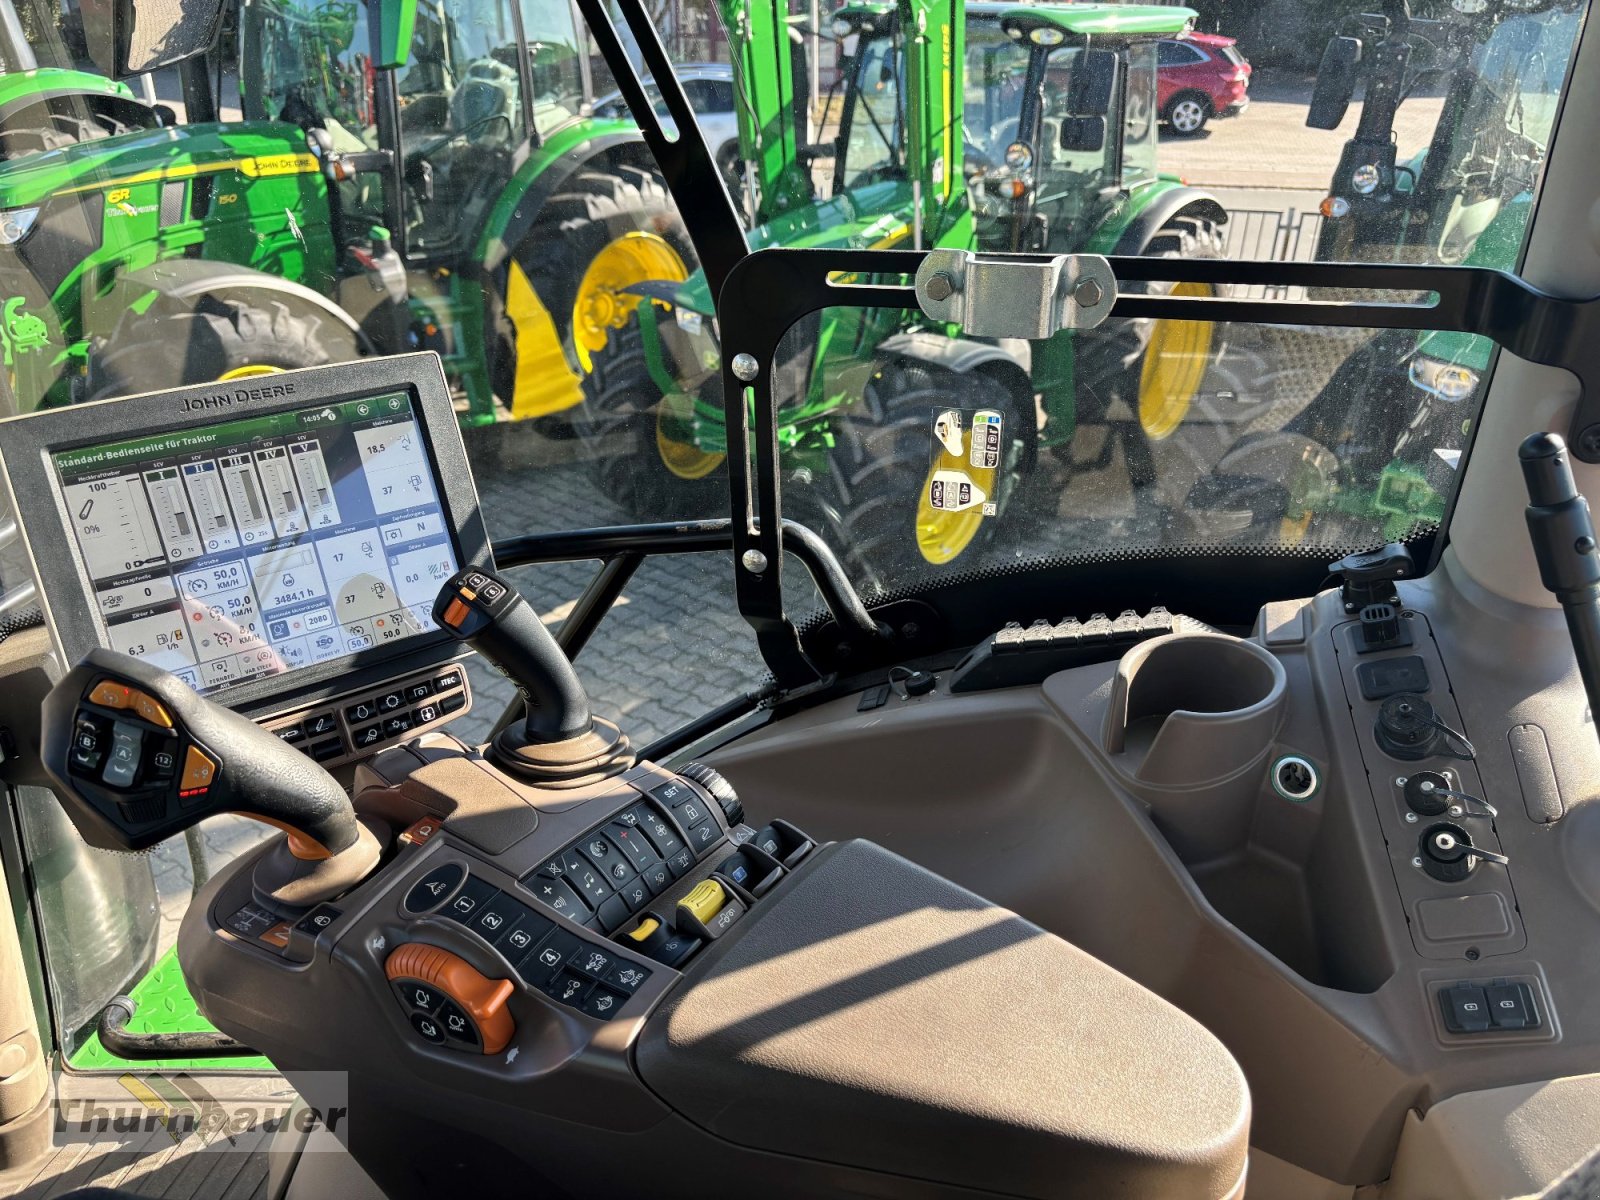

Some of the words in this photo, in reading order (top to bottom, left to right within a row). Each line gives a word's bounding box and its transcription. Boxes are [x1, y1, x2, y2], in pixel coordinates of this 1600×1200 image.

[107, 188, 130, 203] 6R
[218, 193, 237, 205] 150
[180, 393, 231, 413] JOHN
[233, 383, 296, 404] DEERE
[58, 442, 165, 469] Standard-Bedienseite
[165, 439, 181, 450] für
[181, 433, 217, 447] Traktor
[264, 449, 277, 460] IV
[366, 443, 386, 455] 18,5
[229, 455, 243, 466] III
[88, 481, 107, 493] 100
[382, 486, 393, 496] 37
[83, 524, 101, 535] 0%
[417, 522, 426, 531] N
[333, 553, 344, 563] 17
[125, 562, 132, 570] 0
[213, 567, 238, 581] 50,0
[217, 579, 239, 590] KM/H
[144, 587, 152, 597] 0
[307, 588, 314, 597] h
[227, 595, 251, 609] 50,0
[344, 594, 355, 605] 37
[231, 607, 253, 618] KM/H
[308, 614, 328, 625] 2080
[238, 633, 261, 645] KM/H
[383, 628, 401, 640] 50,0
[315, 637, 334, 647] ISO
[351, 637, 369, 649] 50,0
[128, 644, 145, 656] 6,3
[440, 676, 456, 687] ITEC
[83, 737, 91, 747] B
[118, 749, 127, 758] A
[159, 755, 169, 764] 12
[664, 785, 680, 799] SET
[433, 882, 447, 896] AUTO
[459, 900, 470, 909] 1
[486, 915, 498, 926] 2
[514, 934, 526, 945] 3
[545, 952, 557, 962] 4
[593, 957, 607, 972] AUTO
[630, 972, 644, 987] AUTO
